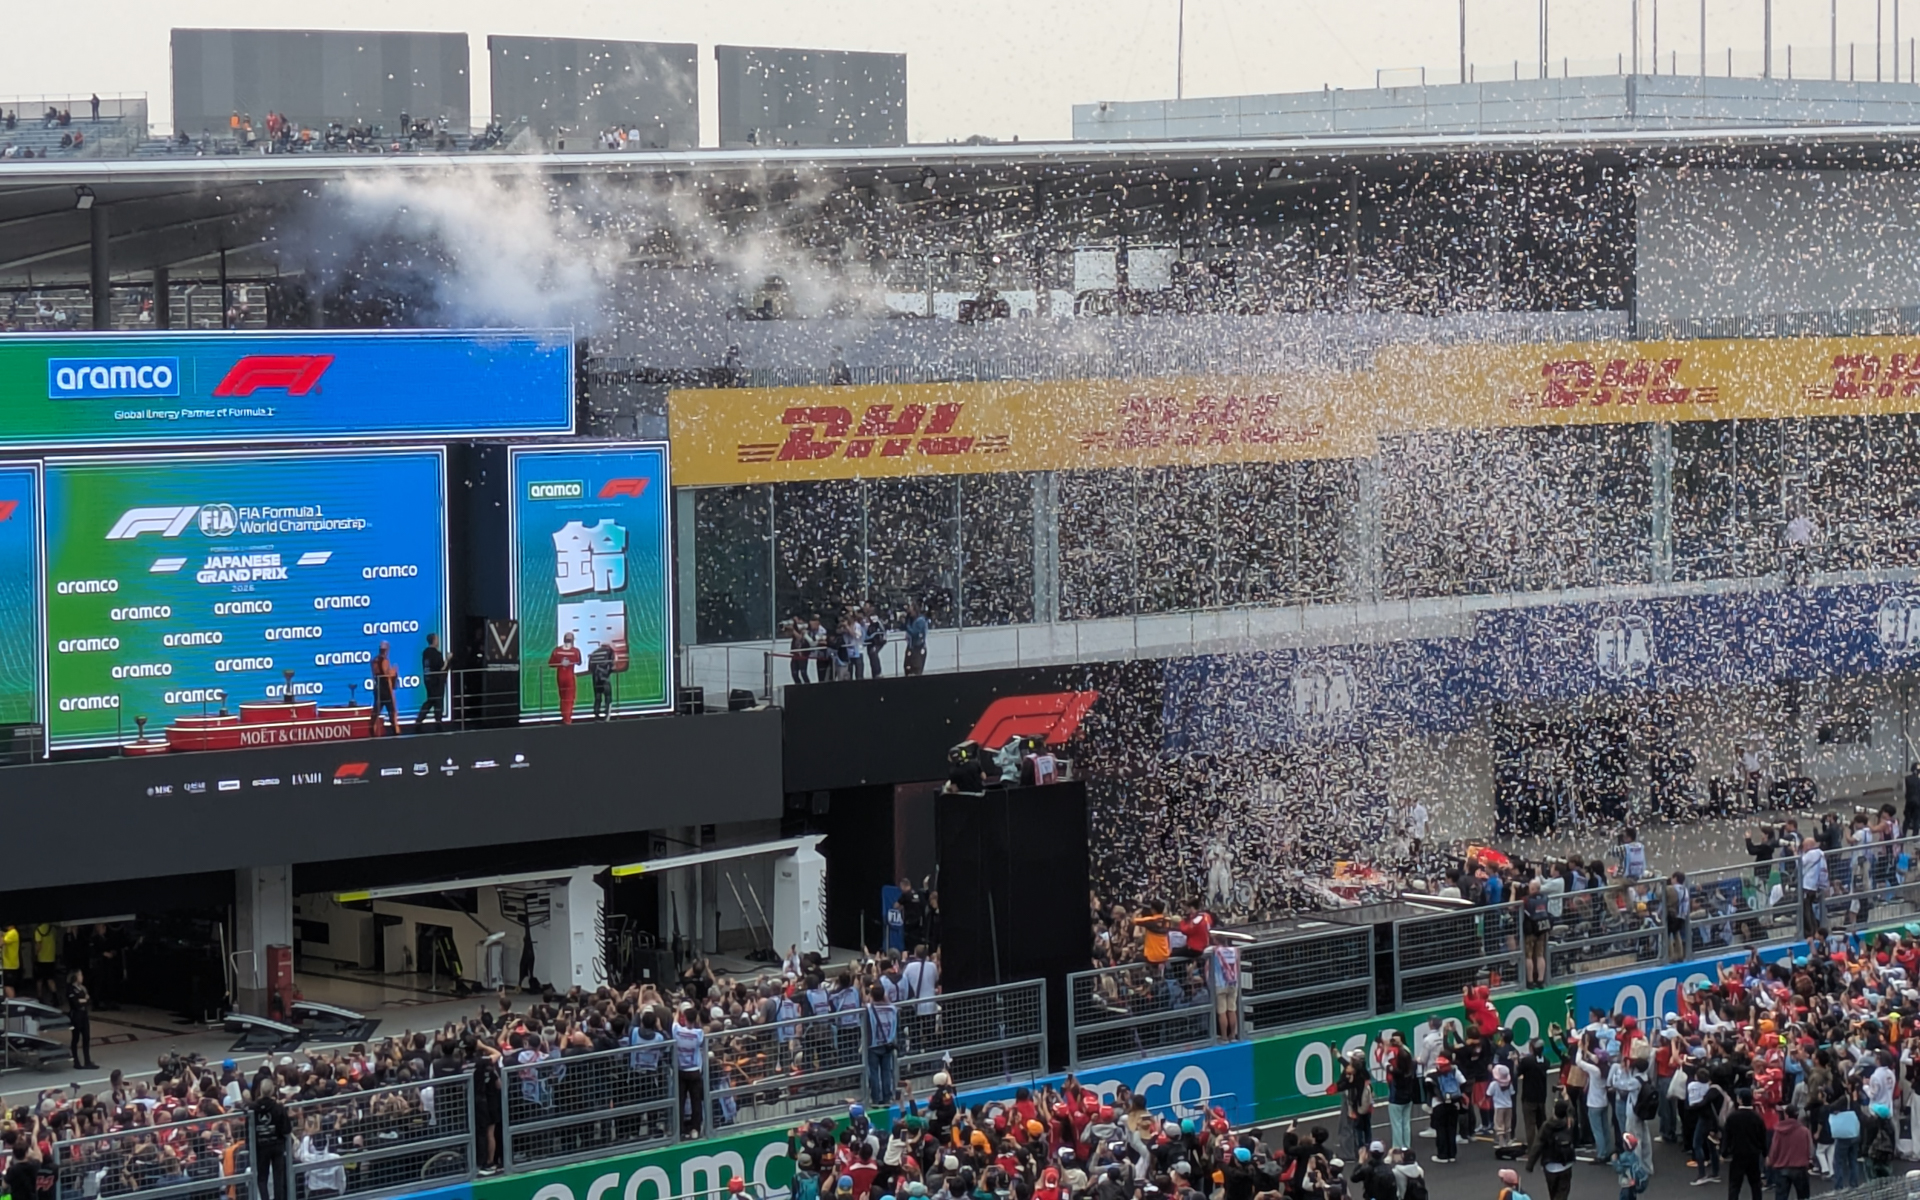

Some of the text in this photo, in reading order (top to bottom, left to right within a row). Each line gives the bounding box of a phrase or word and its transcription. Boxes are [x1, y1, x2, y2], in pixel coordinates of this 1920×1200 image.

[57, 366, 172, 389] aramco
[1538, 358, 1692, 408] DHL
[1830, 353, 1920, 399] DH
[114, 410, 146, 420] Global
[146, 409, 179, 420] Energy
[182, 408, 215, 418] Partner
[229, 407, 266, 417] Formula
[1115, 394, 1284, 449] DHL
[776, 402, 974, 461] DHL
[531, 484, 581, 498] aramco
[239, 505, 323, 519] FIA Formula 1
[239, 517, 366, 534] World Championship
[204, 553, 281, 569] JAPANESE
[197, 567, 289, 583] GRAND PRIX
[362, 565, 418, 579] aramco
[57, 579, 119, 594] aramco
[214, 600, 273, 615] aramco
[314, 595, 371, 610] aramco
[110, 605, 171, 621] aramco
[265, 626, 323, 640] aramco
[363, 620, 419, 634] aramco
[58, 637, 120, 653] aramco
[163, 631, 223, 647] aramco
[215, 656, 273, 671] aramco
[315, 650, 371, 666] aramco
[111, 663, 172, 679] aramco
[59, 695, 120, 711] aramco
[240, 725, 351, 745] MOËT & CHANDON
[815, 869, 829, 951] Cadillac
[592, 899, 608, 985] Cadillac
